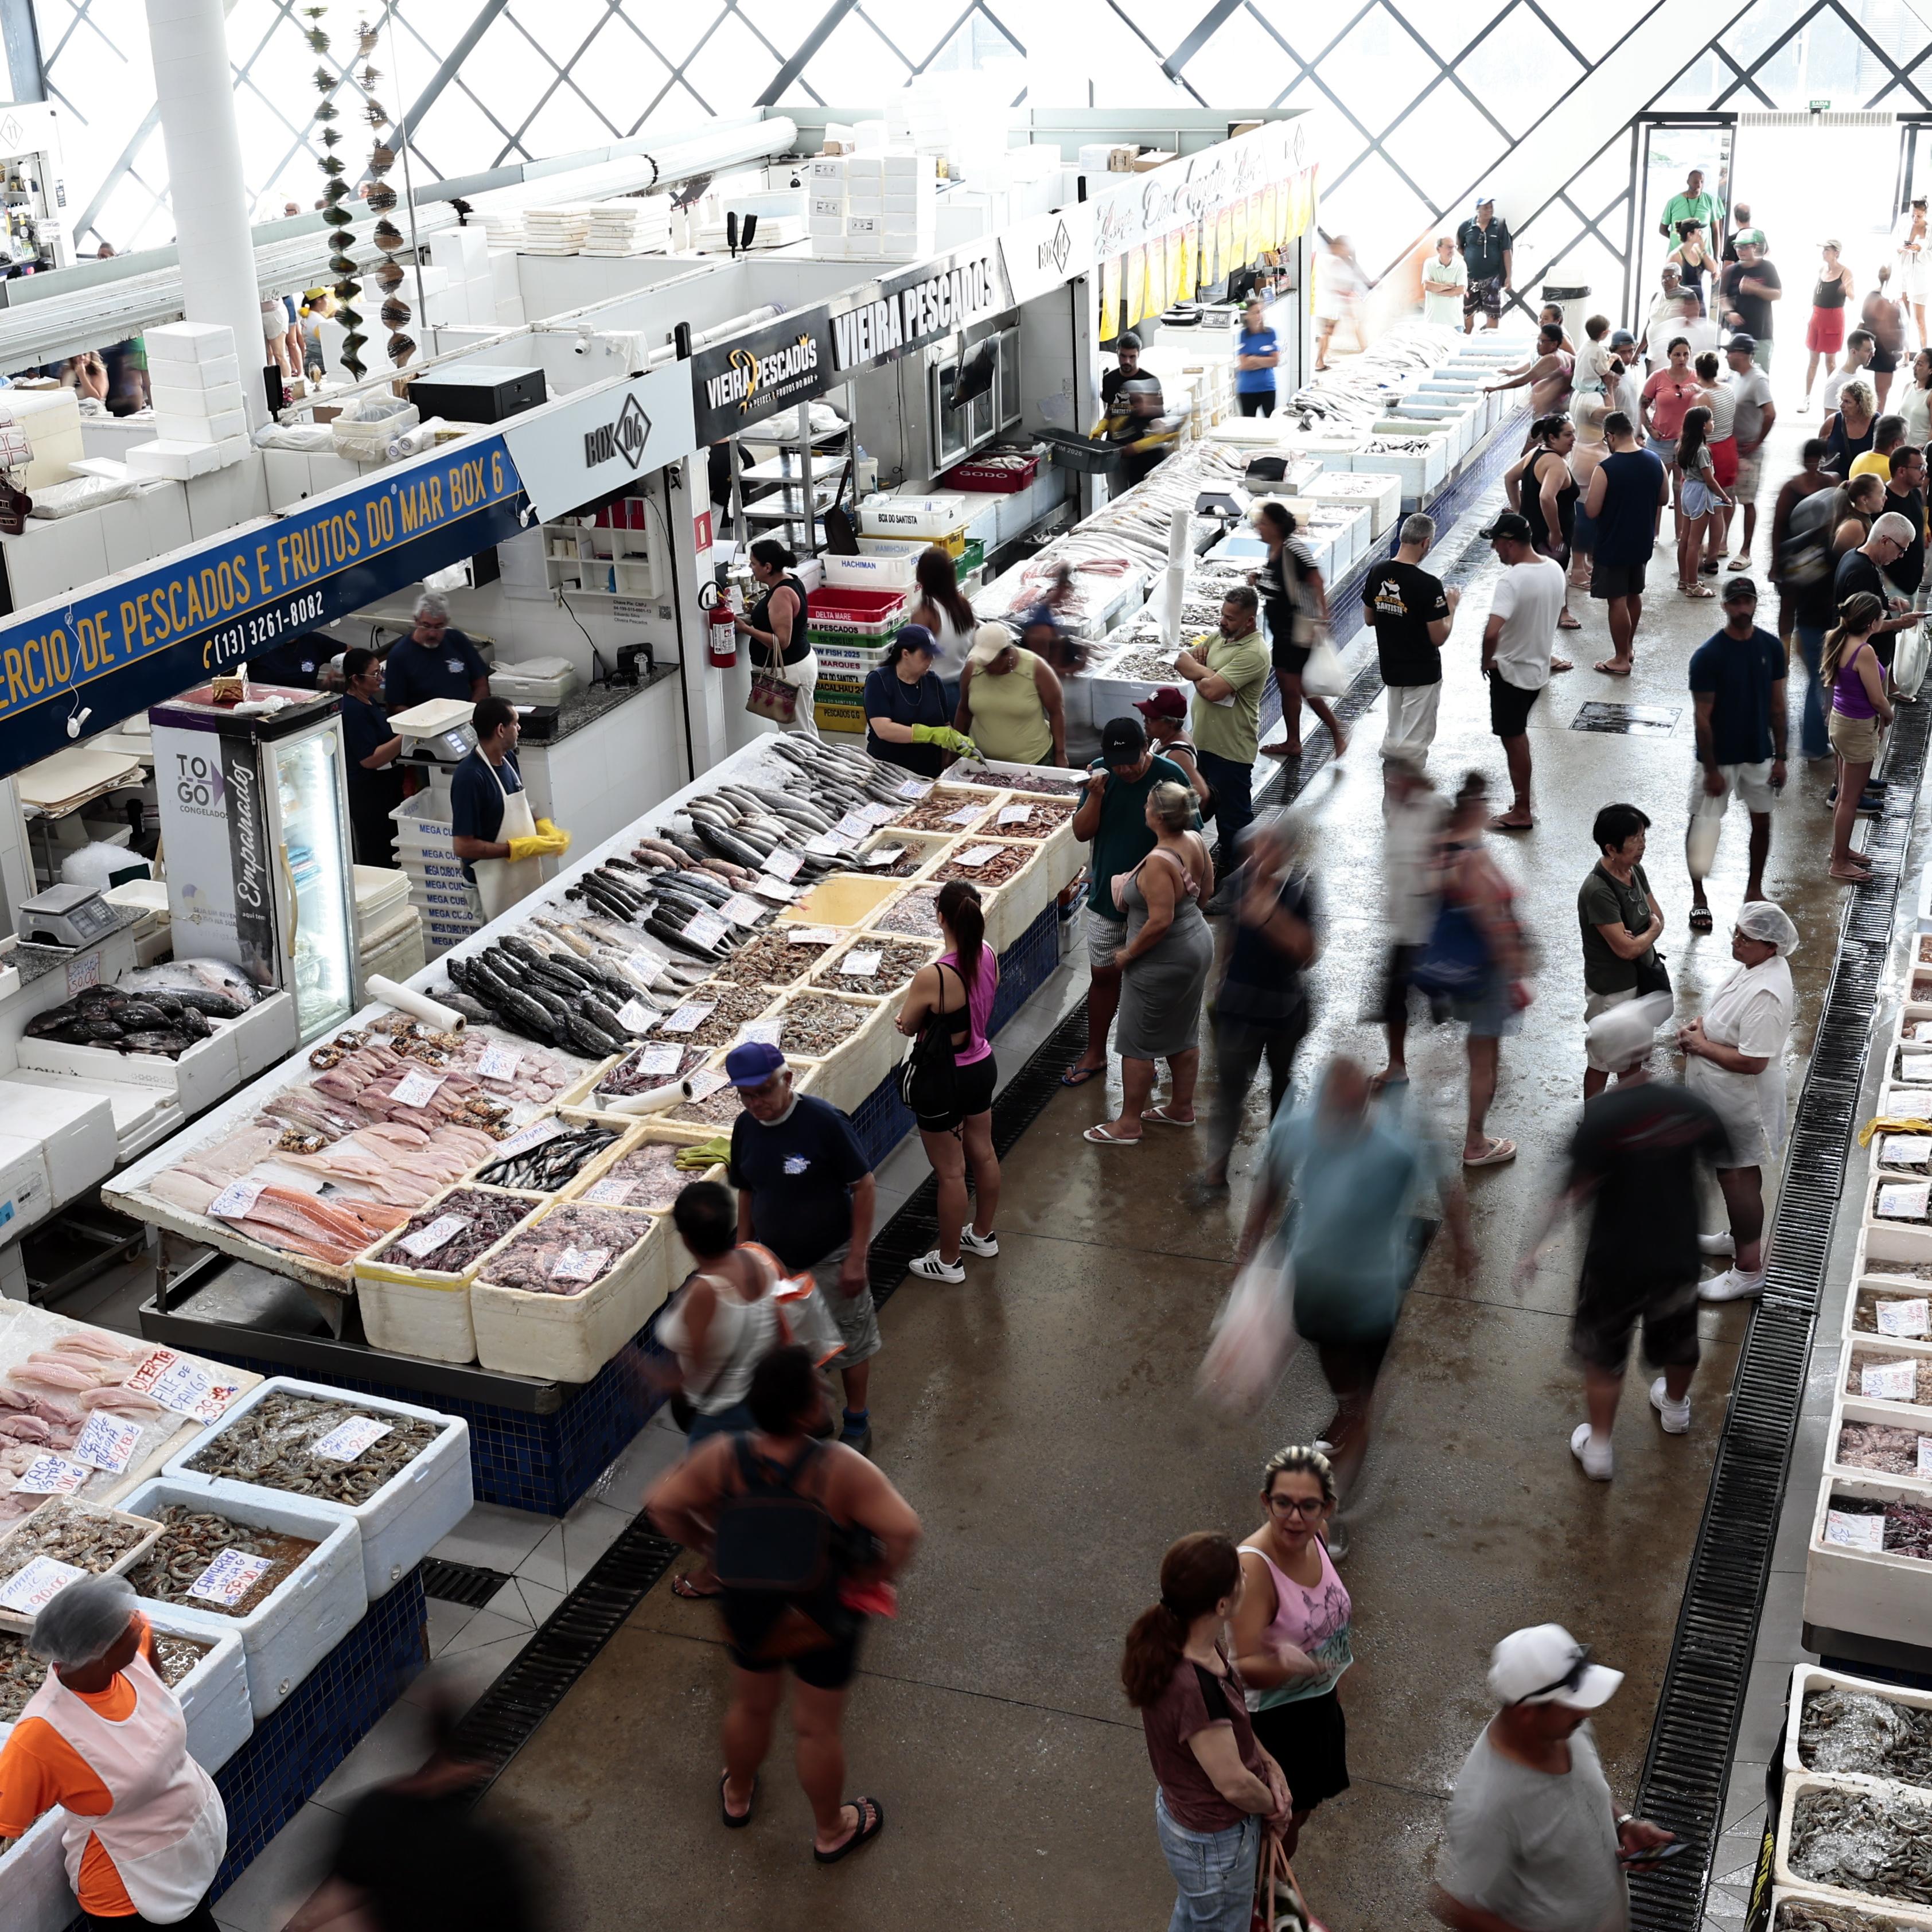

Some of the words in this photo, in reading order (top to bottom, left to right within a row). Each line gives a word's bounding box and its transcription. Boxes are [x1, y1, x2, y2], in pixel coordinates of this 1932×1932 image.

[1038, 239, 1053, 270] BOX
[830, 294, 903, 371] VIEIRA
[903, 257, 995, 343] PESCADOS
[705, 365, 750, 410] VIEIRA
[754, 338, 817, 391] PESCADOS
[753, 396, 772, 408] PEIXES
[776, 384, 795, 398] FRUTOS
[796, 380, 803, 390] DO
[804, 375, 813, 387] MAR
[584, 422, 617, 468] BOX
[624, 412, 644, 451] 06
[960, 470, 1008, 479] GODÓ
[878, 513, 888, 523] BOX
[889, 515, 895, 523] DO
[896, 515, 918, 525] SANTISTA
[77, 610, 115, 672] DE
[120, 555, 251, 653] PESCADOS
[257, 545, 273, 595] E
[278, 510, 360, 586] FRUTOS
[366, 496, 394, 548] DO
[399, 476, 444, 533] MAR
[449, 457, 486, 512] BOX
[492, 451, 503, 493] 6
[842, 559, 877, 569] HACHIMAN
[1376, 602, 1404, 614] SANTISTA
[816, 610, 834, 619] DELTA
[835, 613, 851, 621] MARE
[215, 624, 245, 664] (13)
[249, 591, 324, 645] 3261-8082
[819, 624, 859, 633] PESCADOS
[826, 649, 842, 657] FISH
[821, 660, 860, 669] MARQUES
[815, 683, 854, 693] BACALHAU
[824, 708, 850, 718] PESCADOS
[176, 754, 207, 778] TO
[177, 782, 209, 807] GO
[180, 805, 229, 820] CONGELADOS
[226, 759, 265, 907] Empanados
[420, 824, 441, 835] MEGA
[422, 850, 443, 859] MEGA
[424, 865, 440, 875] MEGA
[441, 866, 455, 877] CUBO
[426, 880, 446, 890] MEGA
[427, 895, 449, 904] MEGA
[450, 897, 468, 905] CUB
[429, 909, 450, 918] MEGA
[431, 923, 446, 932] MEGA
[447, 924, 461, 934] CUBO
[462, 925, 469, 935] PG
[432, 936, 453, 946] MEGA
[127, 1350, 174, 1389] OFERTA
[177, 1365, 192, 1378] DE
[169, 1373, 210, 1411] PANGA
[1830, 1526, 1850, 1543] 38
[1869, 1517, 1882, 1543] LULA
